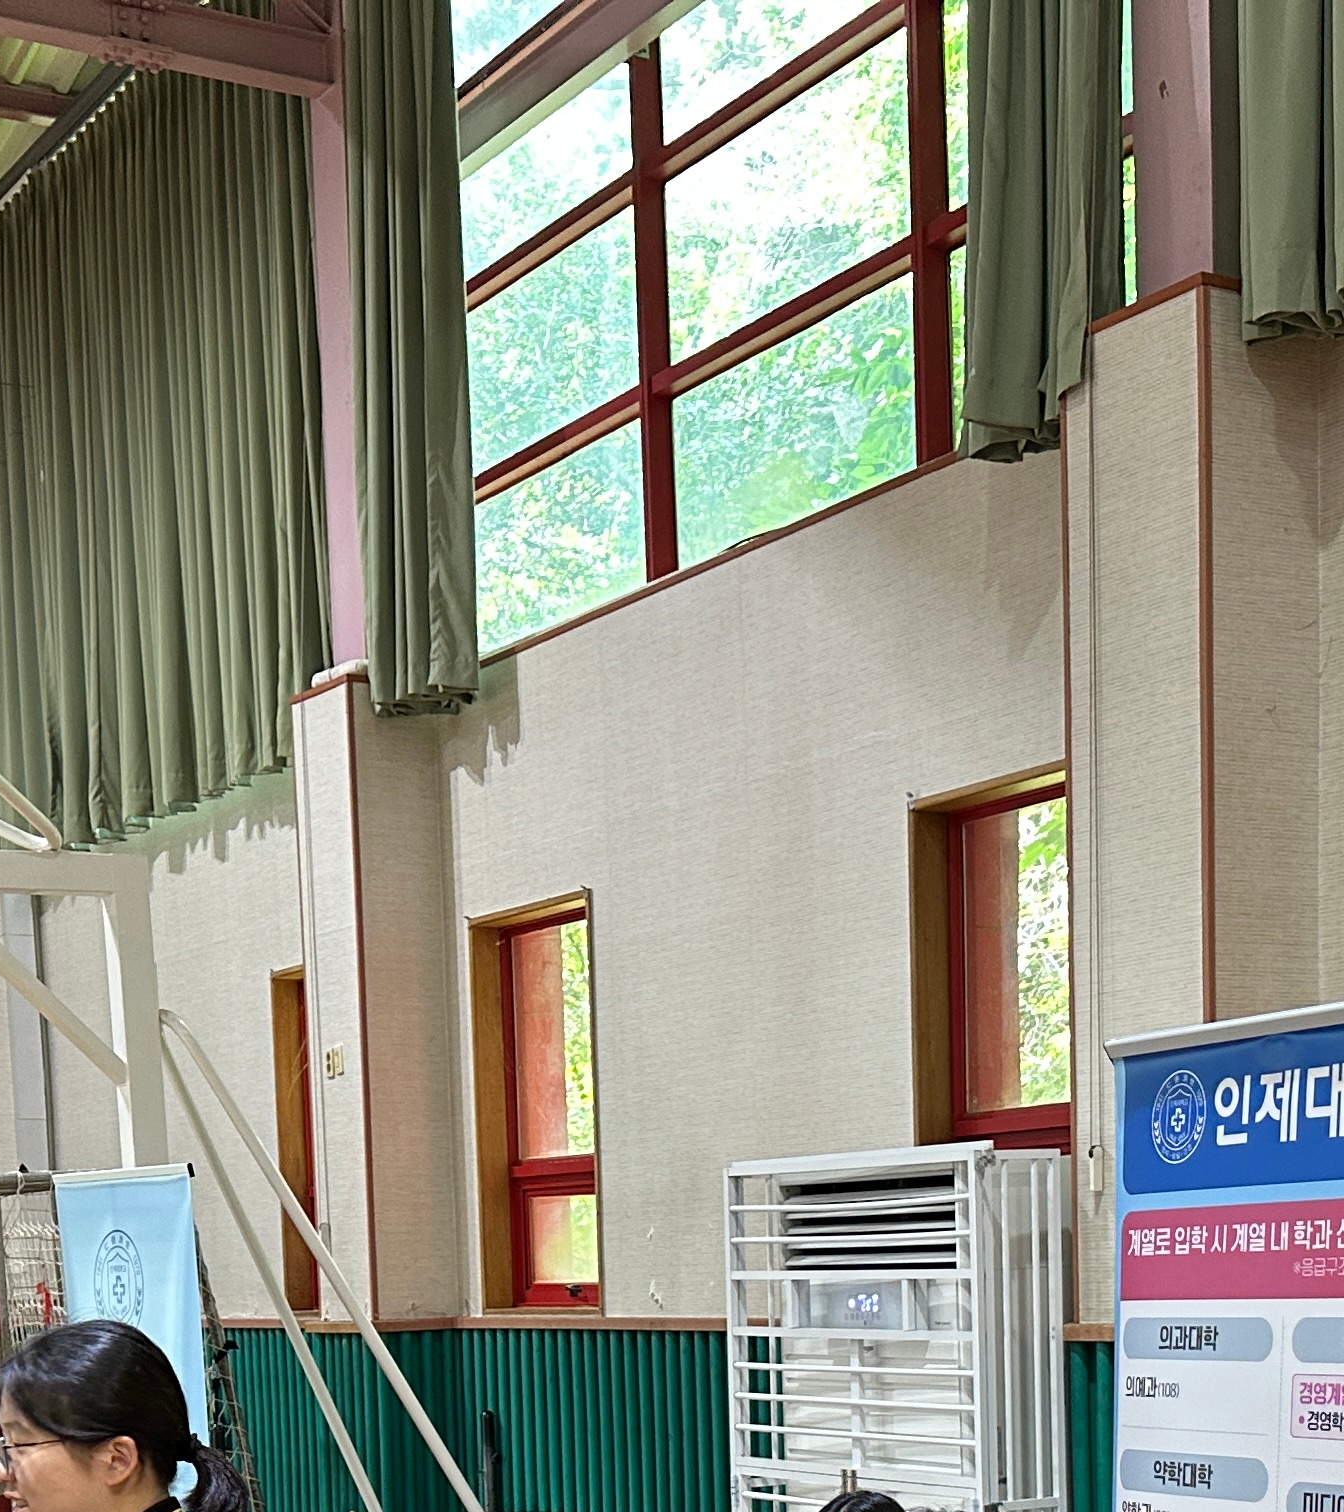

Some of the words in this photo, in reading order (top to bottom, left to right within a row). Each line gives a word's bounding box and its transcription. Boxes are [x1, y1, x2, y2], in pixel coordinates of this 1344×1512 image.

[1128, 1228, 1171, 1257] 계열로
[1175, 1225, 1208, 1255] 입학
[1210, 1224, 1228, 1253] 시
[1231, 1222, 1266, 1253] 계열
[1270, 1221, 1289, 1251] 내
[1294, 1218, 1333, 1251] 학과
[1159, 1326, 1219, 1351] 의과대학
[1125, 1376, 1180, 1399] 의예과(108)
[1153, 1460, 1213, 1489] 약학대학
